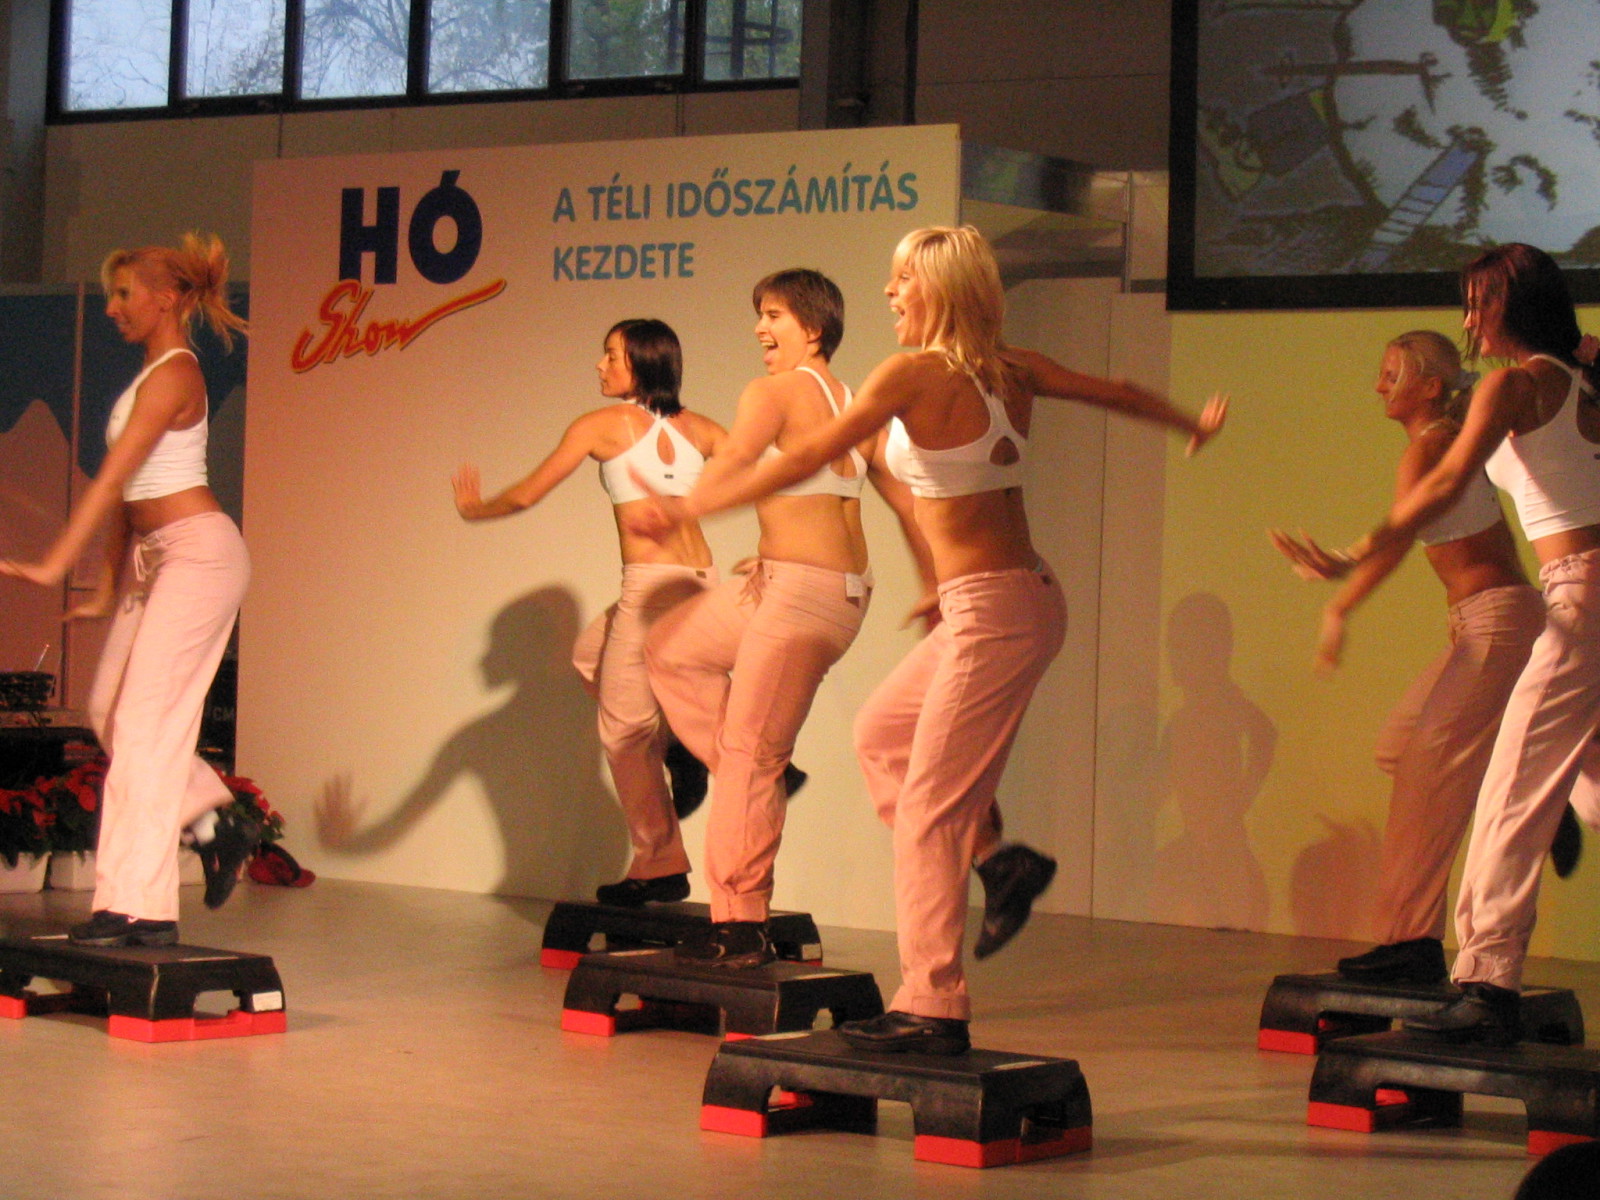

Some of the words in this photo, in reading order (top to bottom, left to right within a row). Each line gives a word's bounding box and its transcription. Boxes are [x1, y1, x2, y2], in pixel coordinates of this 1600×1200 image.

[341, 169, 483, 285] HÓ
[553, 187, 576, 222] A
[588, 172, 651, 221] TÉLI
[667, 159, 918, 219] IDŐSZÁMÍTÁS
[552, 242, 695, 281] KEZDETE
[291, 280, 507, 373] Show
